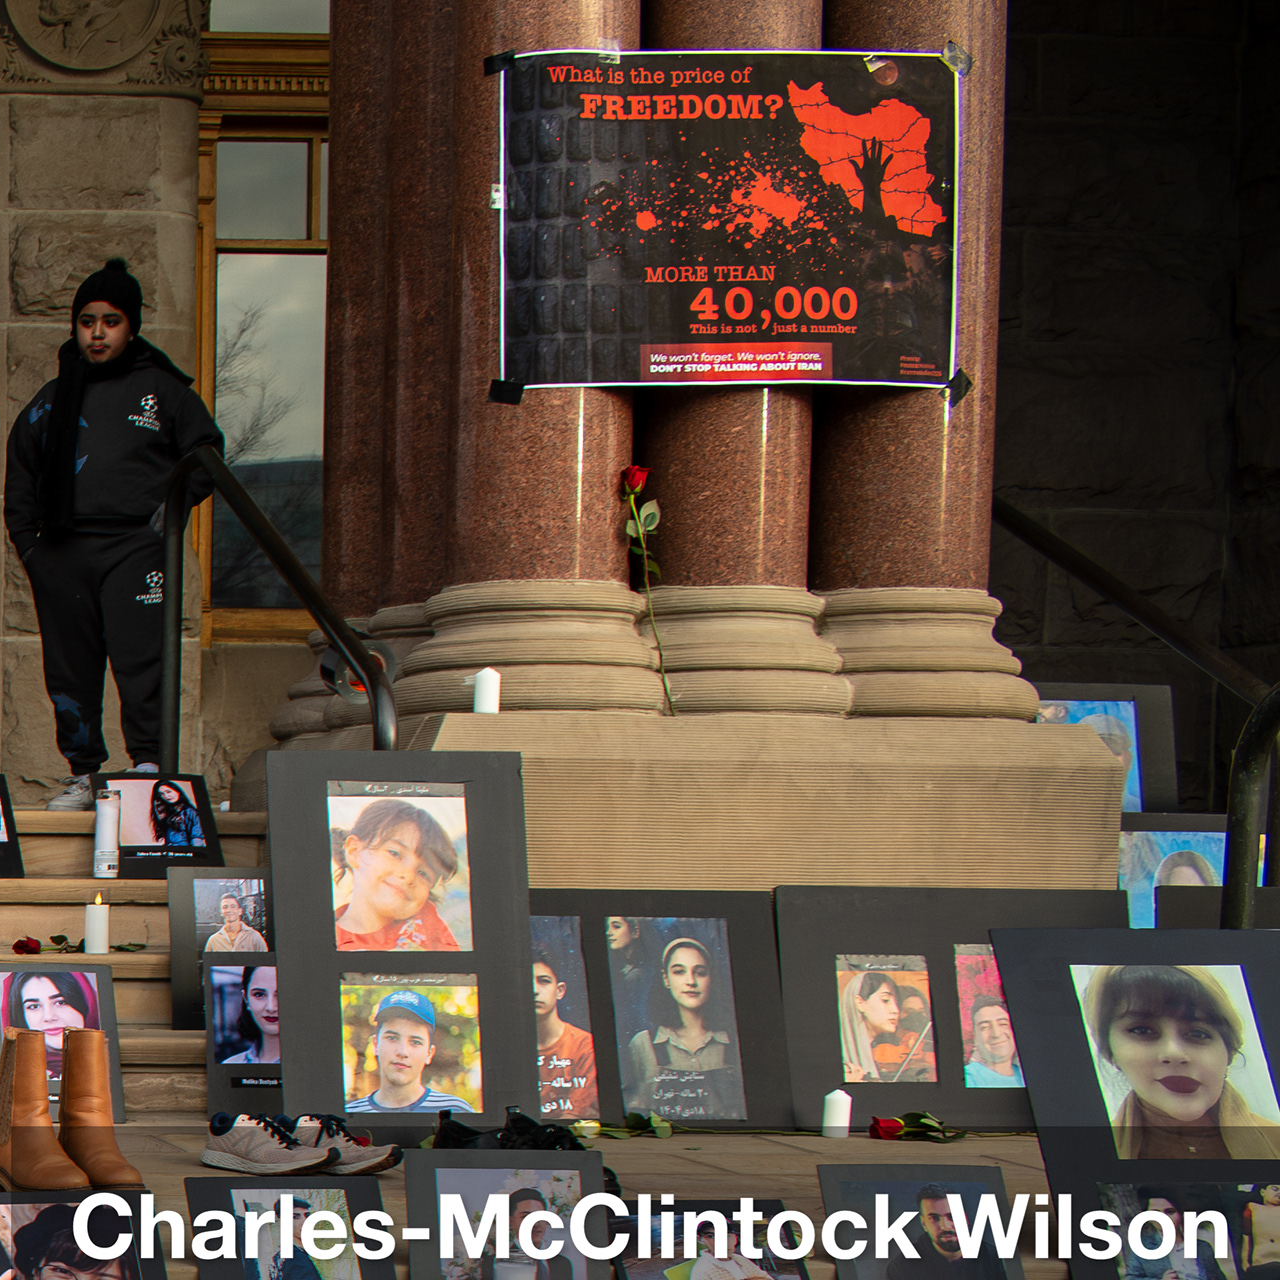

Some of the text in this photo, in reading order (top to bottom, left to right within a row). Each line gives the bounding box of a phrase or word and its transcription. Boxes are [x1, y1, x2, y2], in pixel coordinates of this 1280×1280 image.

[547, 66, 753, 87] What is the price of
[579, 93, 784, 120] FREEDOM?
[644, 265, 776, 283] MORE THAN
[689, 286, 858, 330] 40,000
[690, 323, 858, 335] This is not just a number
[650, 352, 822, 363] We won't forget. We won't ignore.
[650, 362, 823, 373] DON'T STOP TALKING ABOUT IRAN
